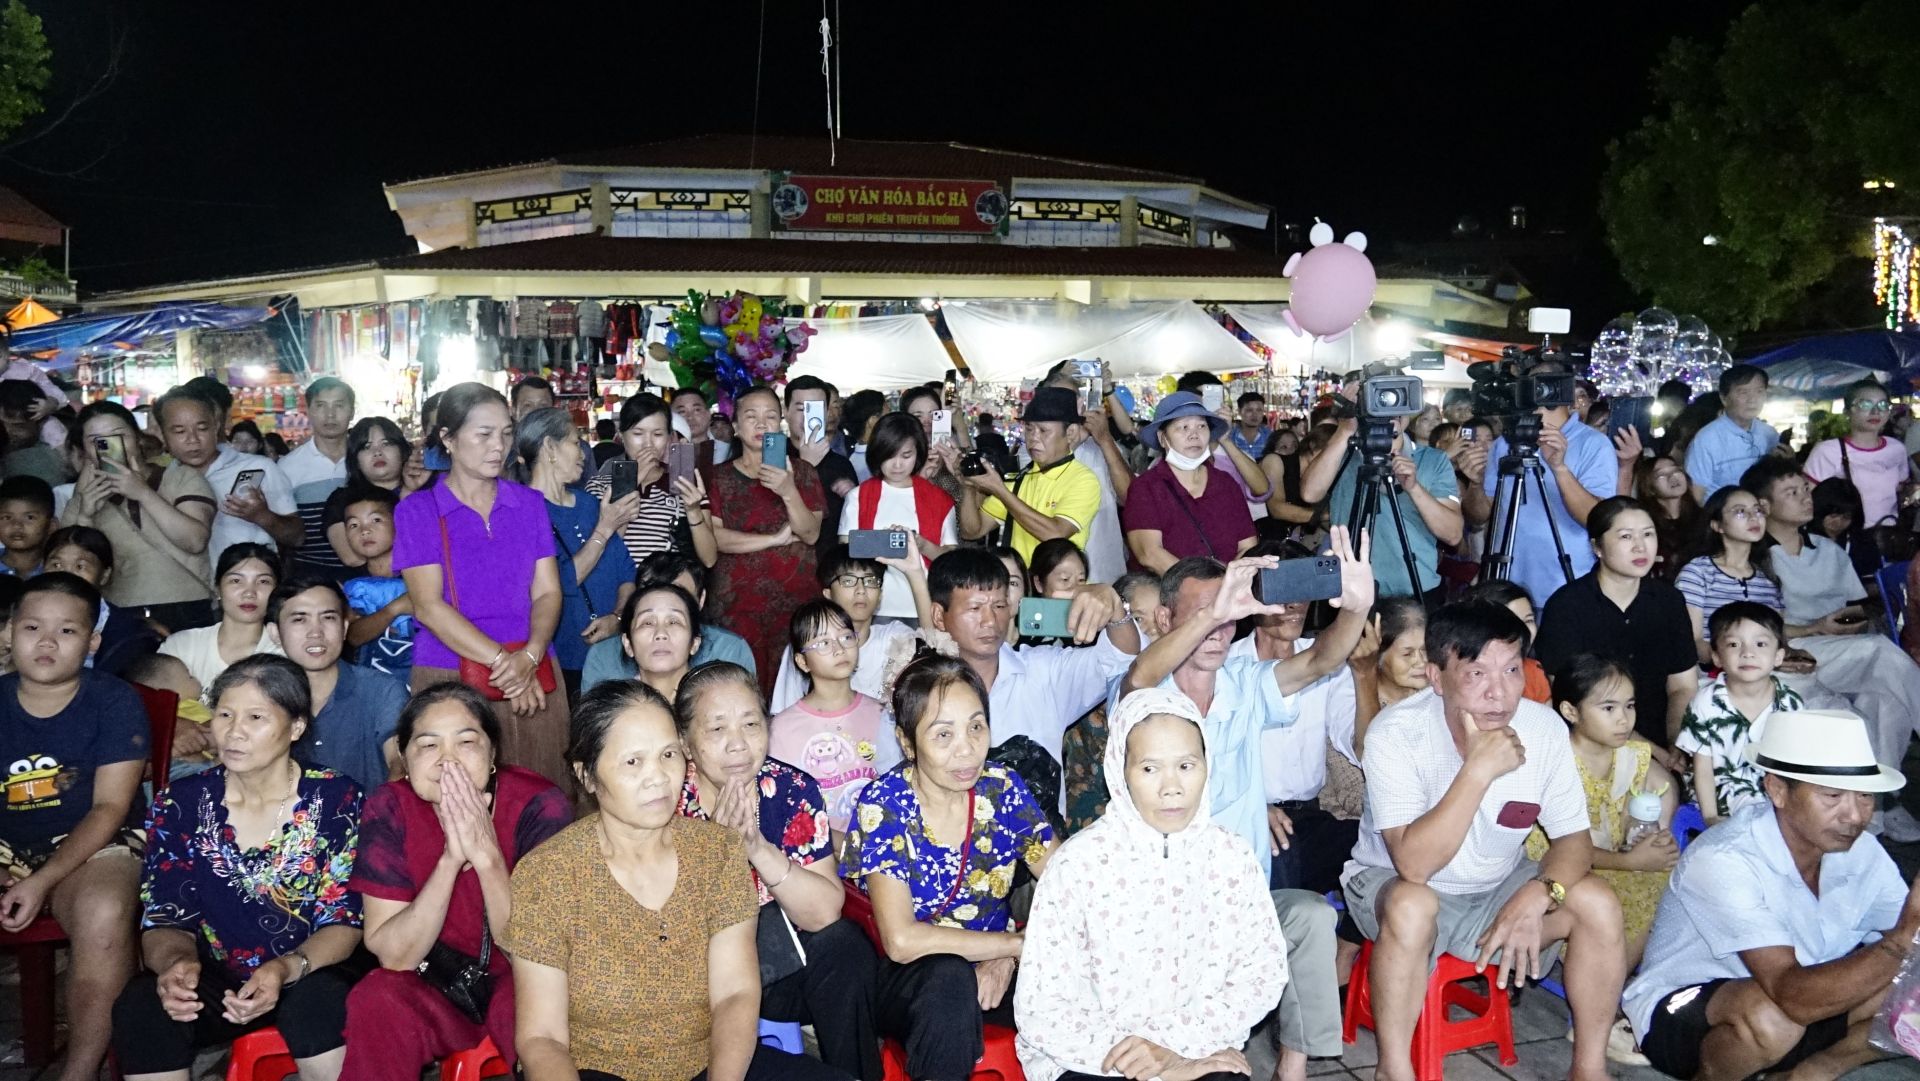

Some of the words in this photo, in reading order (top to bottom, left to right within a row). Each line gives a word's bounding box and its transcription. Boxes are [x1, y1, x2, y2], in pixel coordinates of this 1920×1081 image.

[815, 187, 845, 208] CHỢ
[849, 185, 879, 205] VĂN
[883, 186, 913, 205] HÓA
[917, 184, 945, 206] BẮC
[949, 187, 968, 206] HÀ
